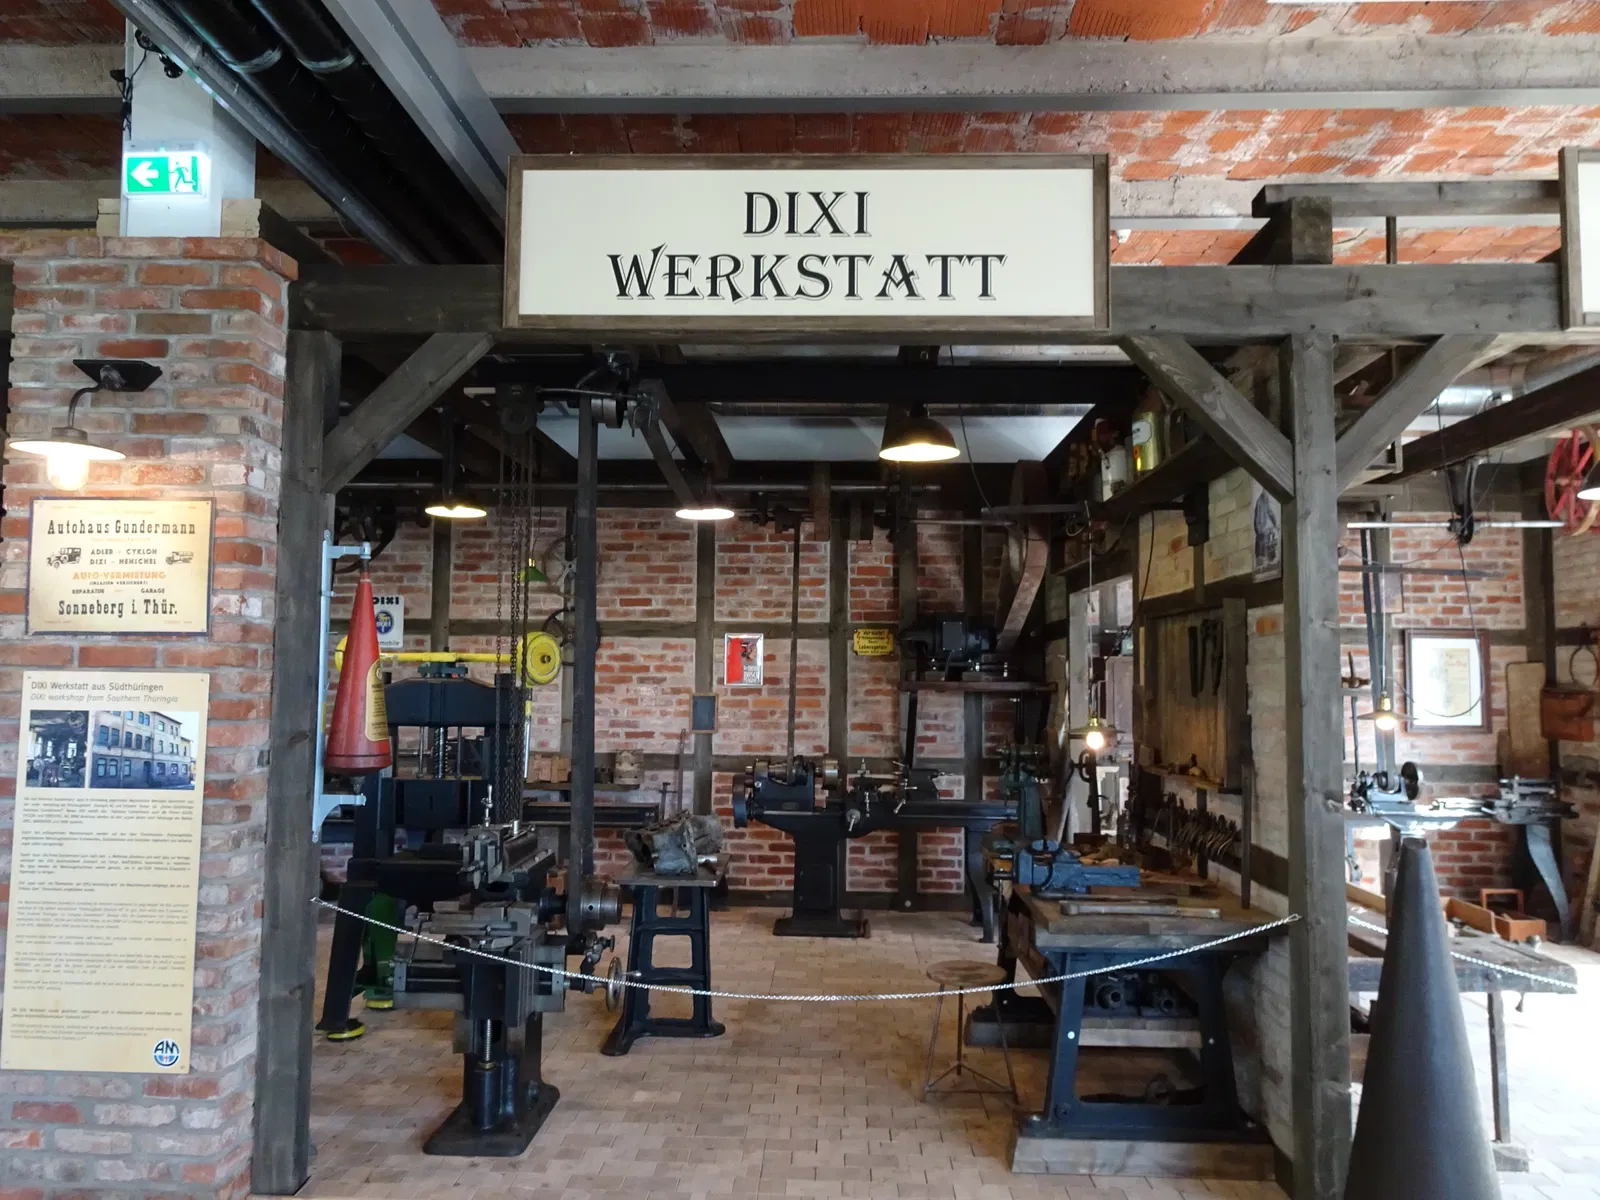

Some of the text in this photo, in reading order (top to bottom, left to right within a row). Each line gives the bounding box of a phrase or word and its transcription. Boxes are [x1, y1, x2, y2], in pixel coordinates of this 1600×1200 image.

[743, 191, 873, 237] DIXI
[606, 243, 1008, 305] WERKSTATT
[47, 519, 196, 535] Autohaus Gundermann
[58, 599, 125, 619] Sonneberg
[143, 598, 178, 615] Thür.
[31, 681, 164, 693] DIXI Werkstatt aus Südthüringen
[48, 693, 85, 703] workshop
[86, 693, 104, 703] from
[107, 694, 141, 702] Southern
